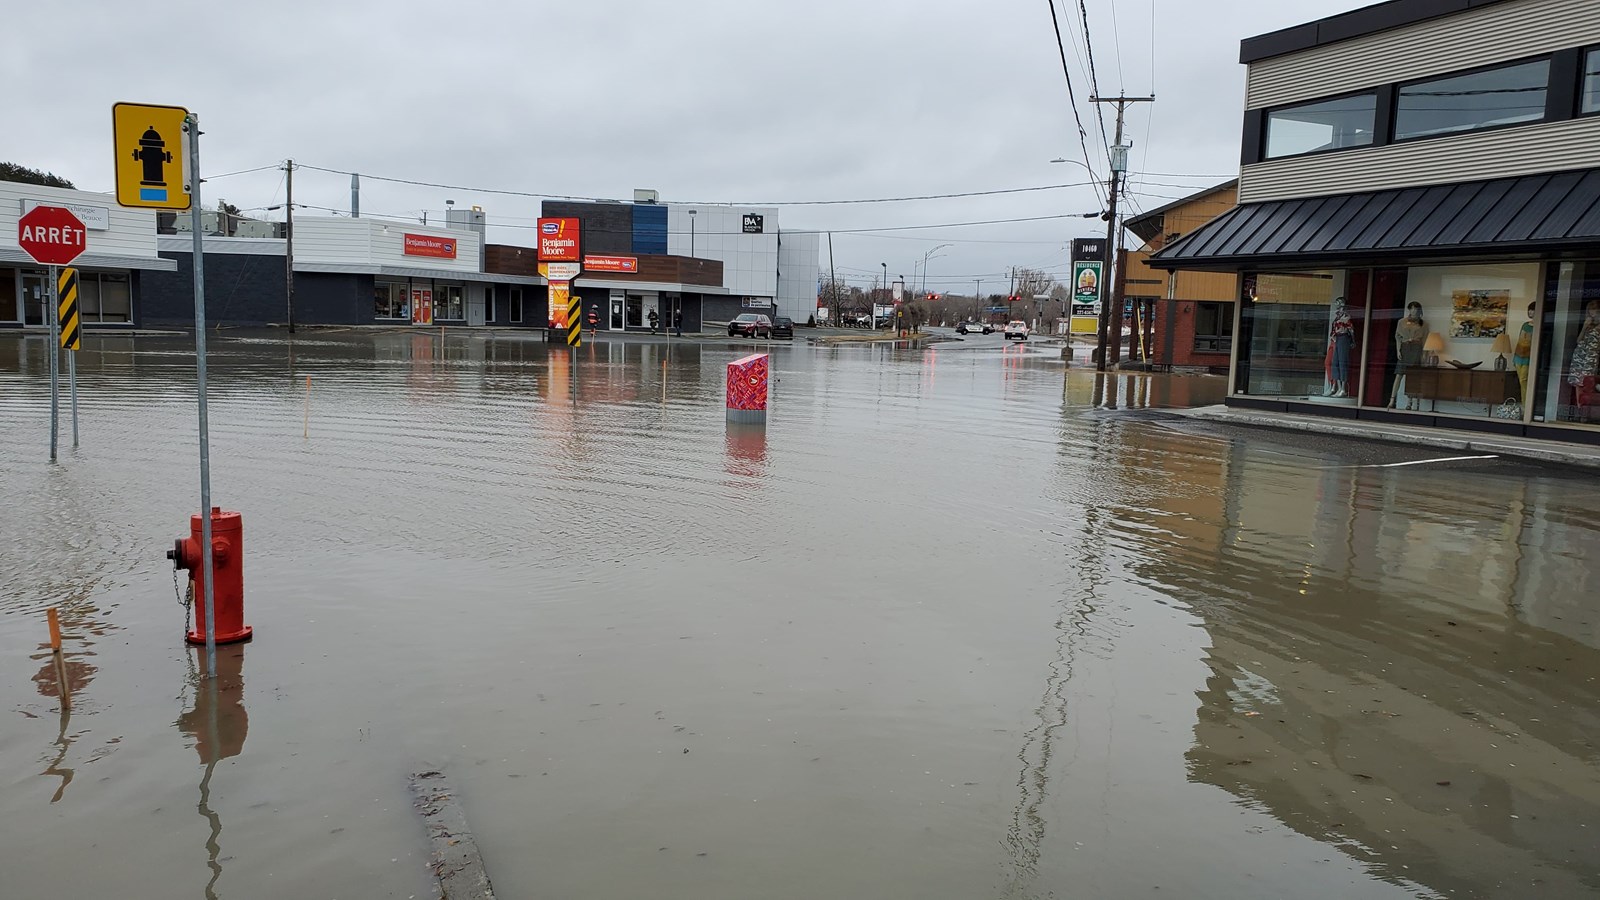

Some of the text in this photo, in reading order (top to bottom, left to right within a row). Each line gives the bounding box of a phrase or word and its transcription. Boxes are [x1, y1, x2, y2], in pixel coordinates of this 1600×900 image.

[21, 225, 83, 245] ARRÊT
[406, 238, 427, 247] Benjamin
[427, 240, 442, 248] Moore
[542, 238, 575, 248] Benjamin
[542, 247, 565, 255] Moore
